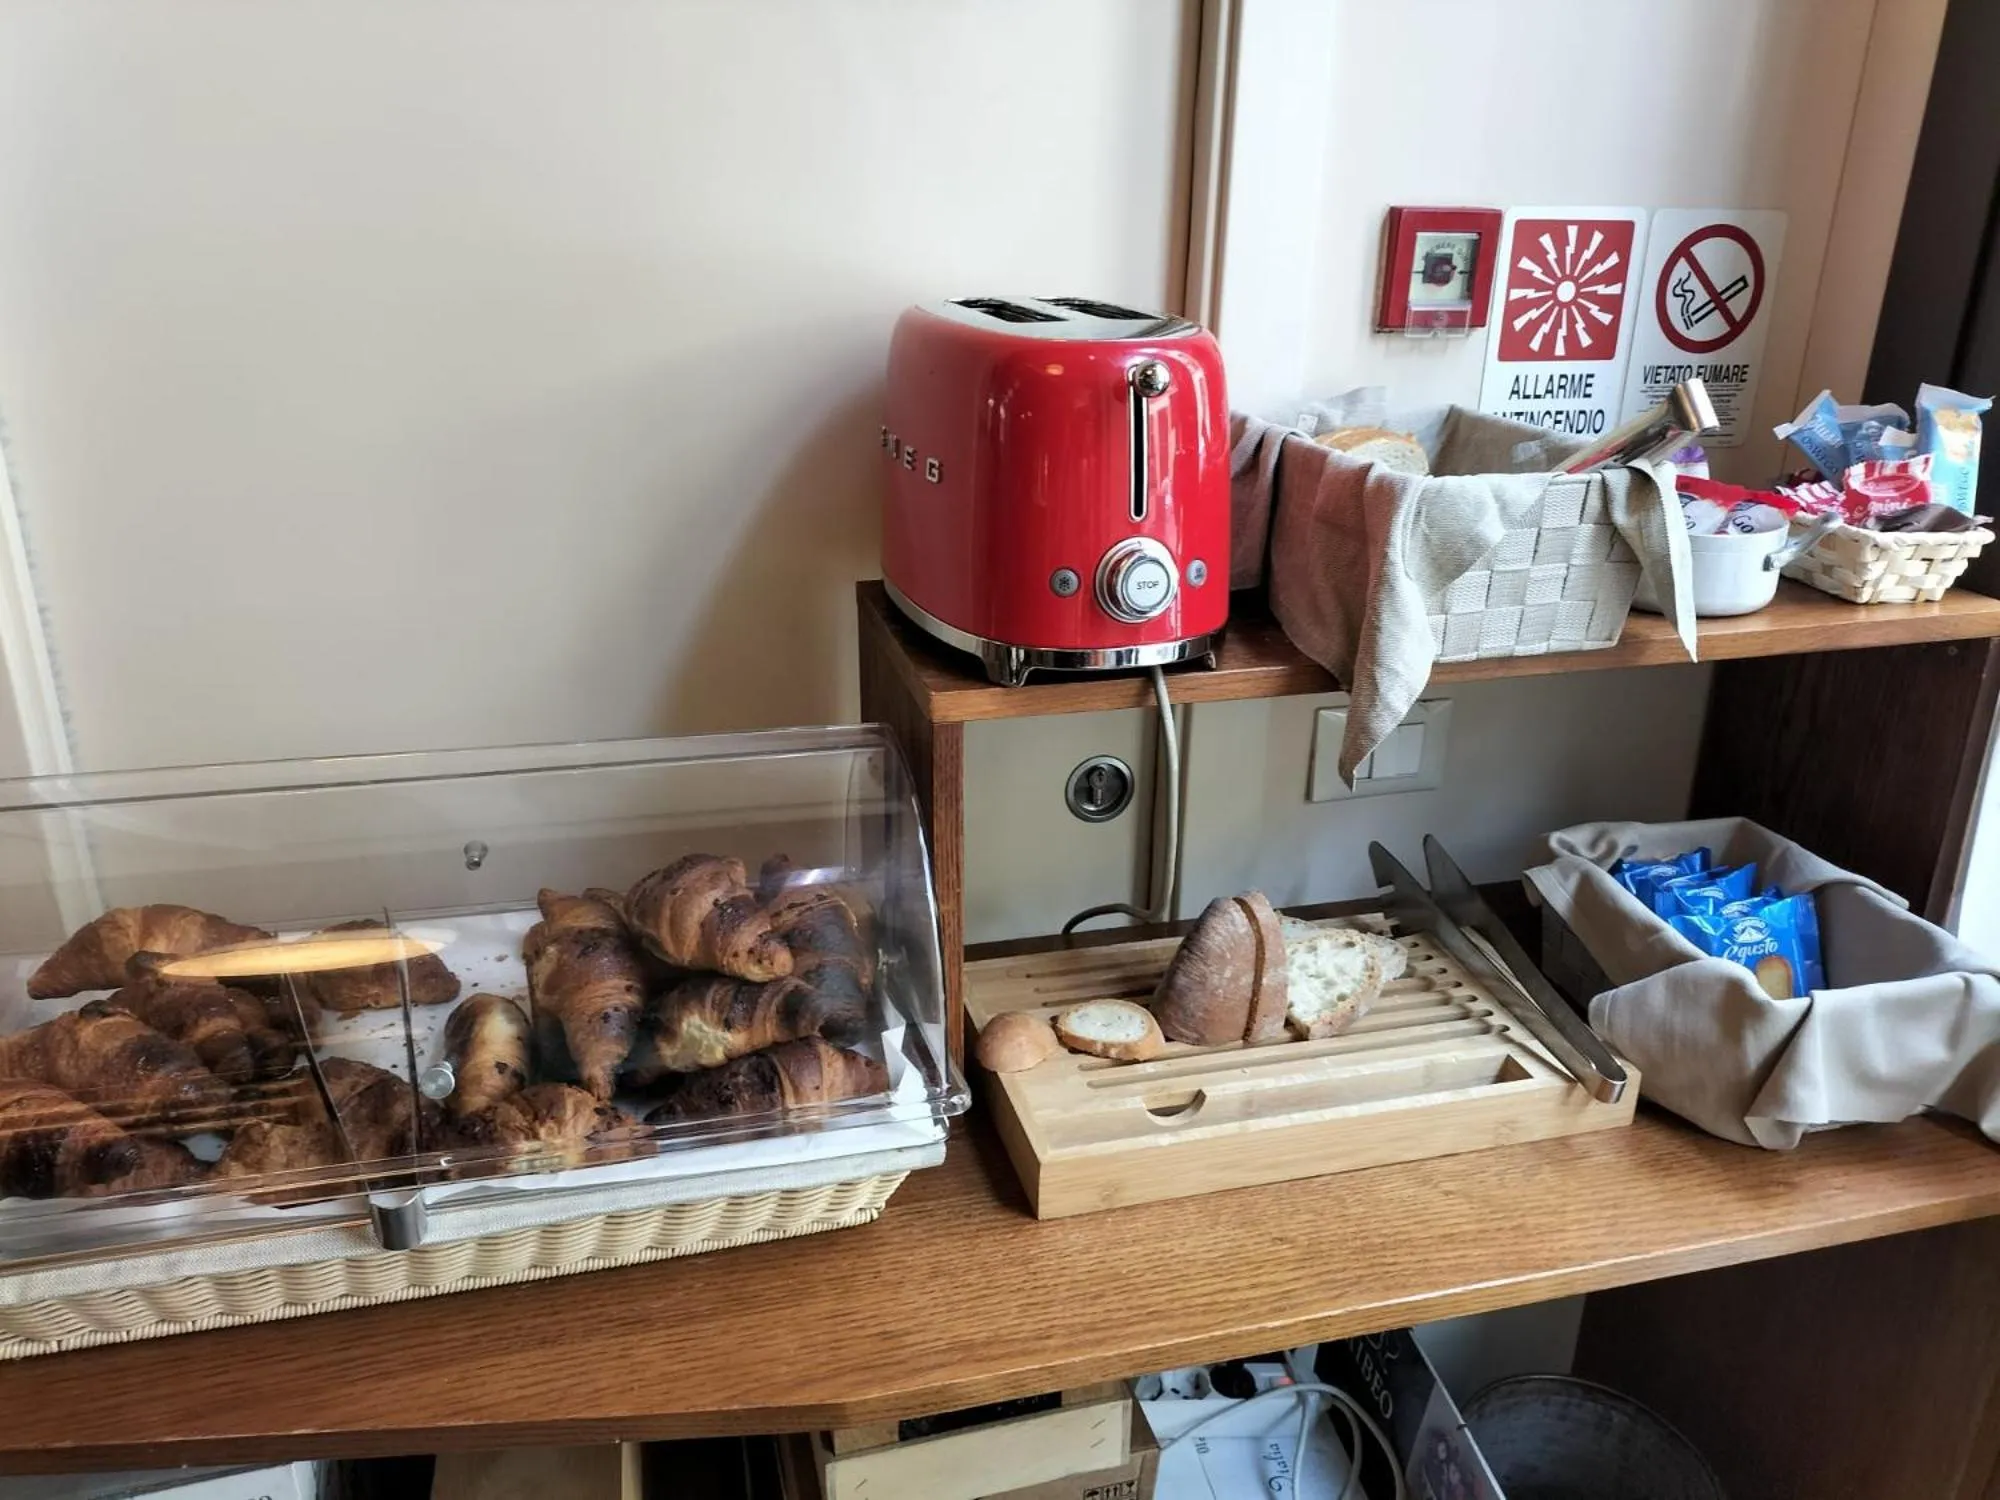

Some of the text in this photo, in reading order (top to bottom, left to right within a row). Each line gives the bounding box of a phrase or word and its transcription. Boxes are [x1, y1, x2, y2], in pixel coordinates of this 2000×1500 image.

[1642, 364, 1750, 384] VIETATO FUMARE
[1508, 373, 1595, 400] ALLARME
[1136, 580, 1159, 590] STOP
